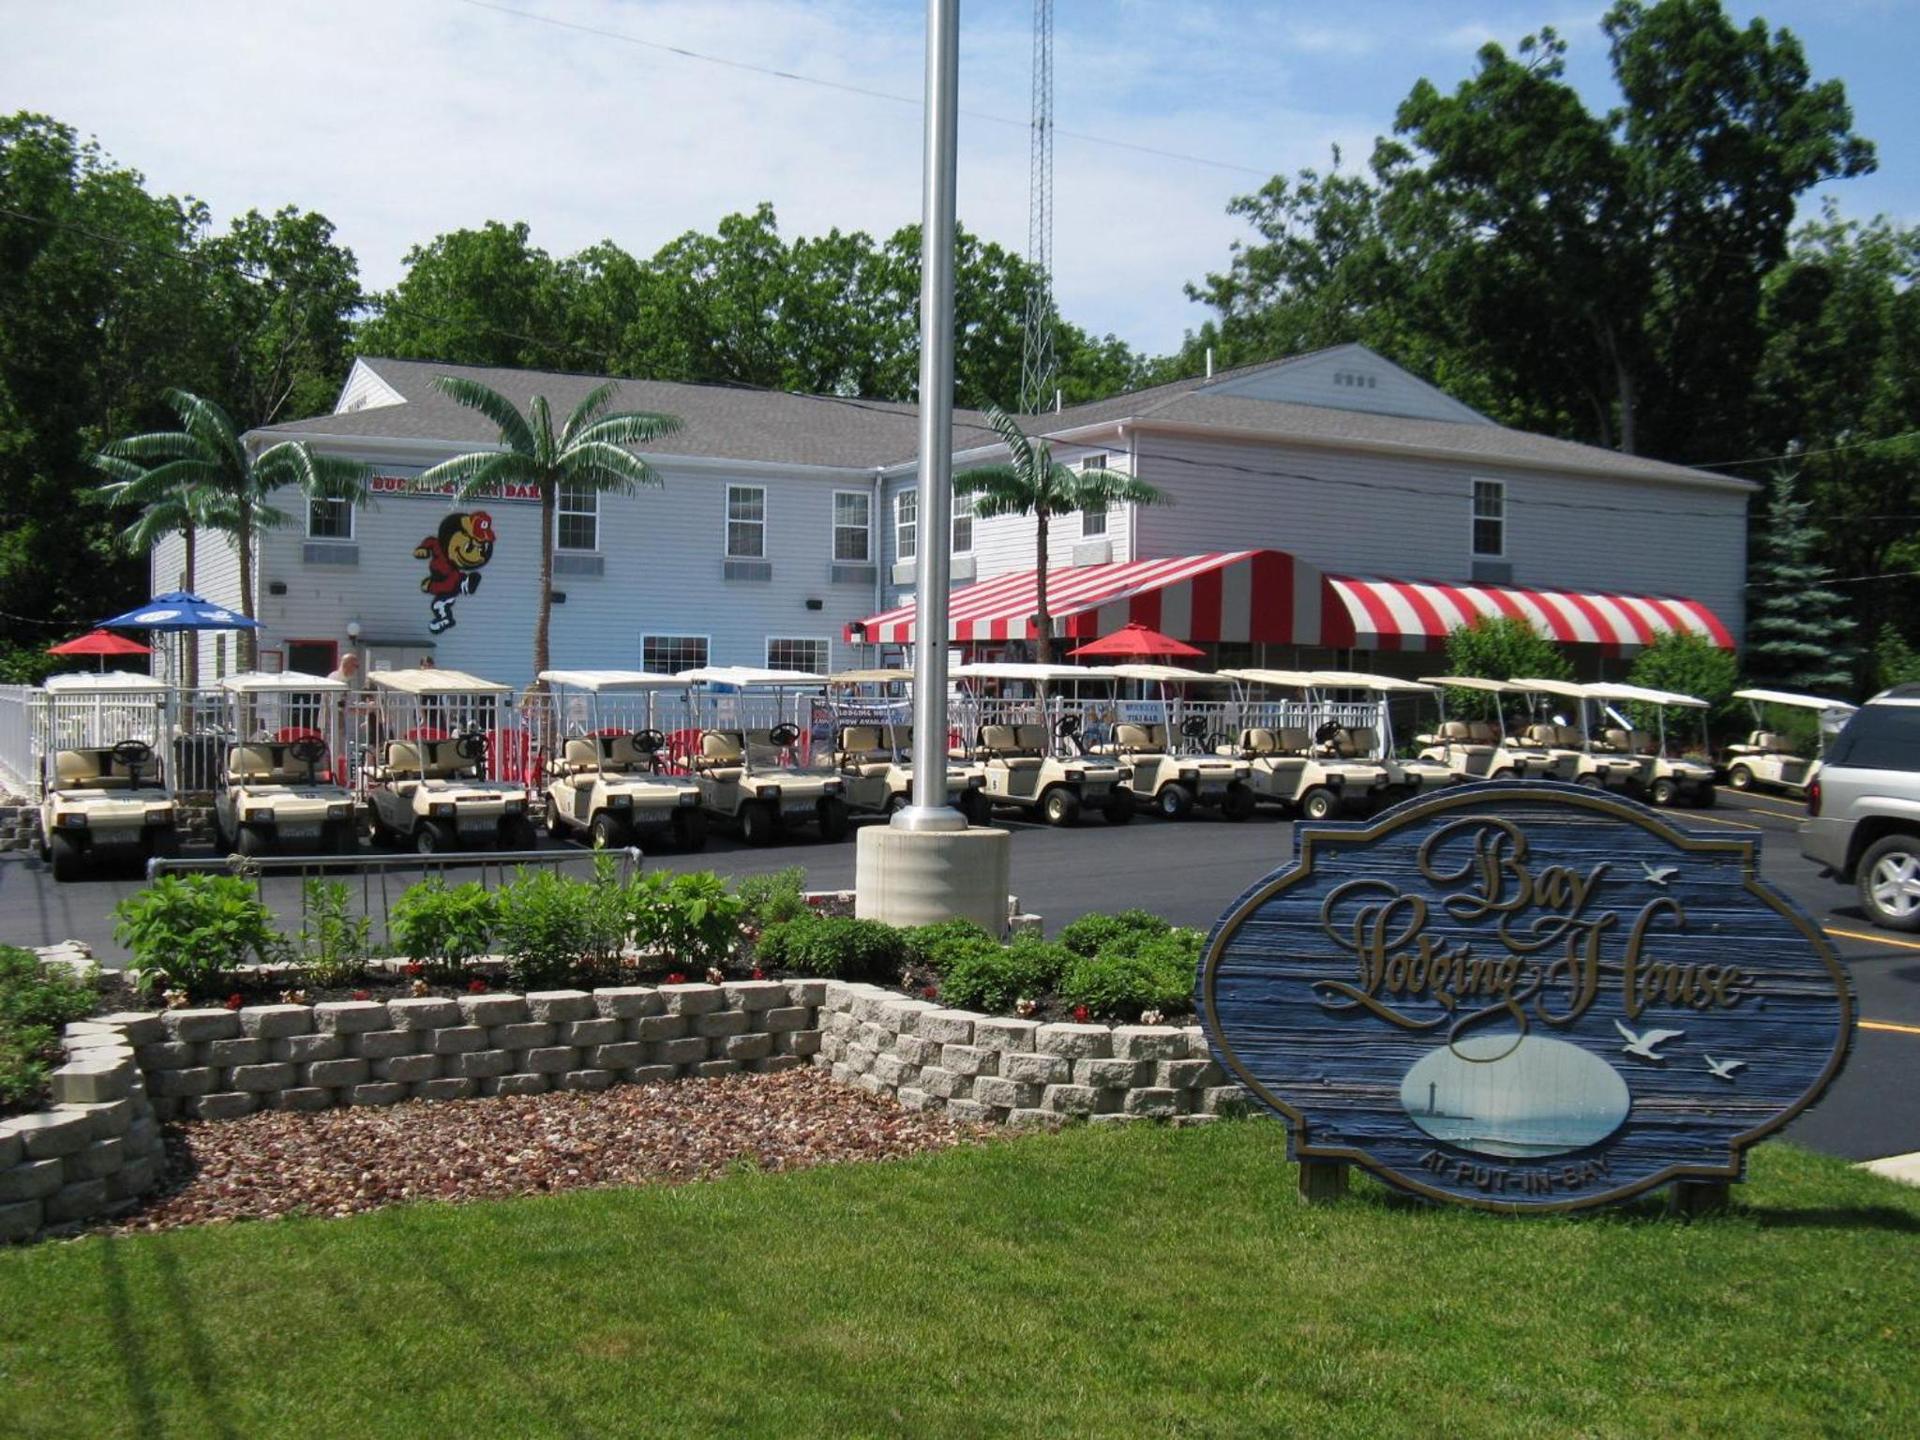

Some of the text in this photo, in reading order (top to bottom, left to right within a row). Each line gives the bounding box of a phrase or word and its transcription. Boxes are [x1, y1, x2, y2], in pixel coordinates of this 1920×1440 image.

[1417, 816, 1613, 951] Bay
[1311, 879, 1757, 1063] Lodging House
[1455, 1151, 1615, 1194] PUT-IN-BAY
